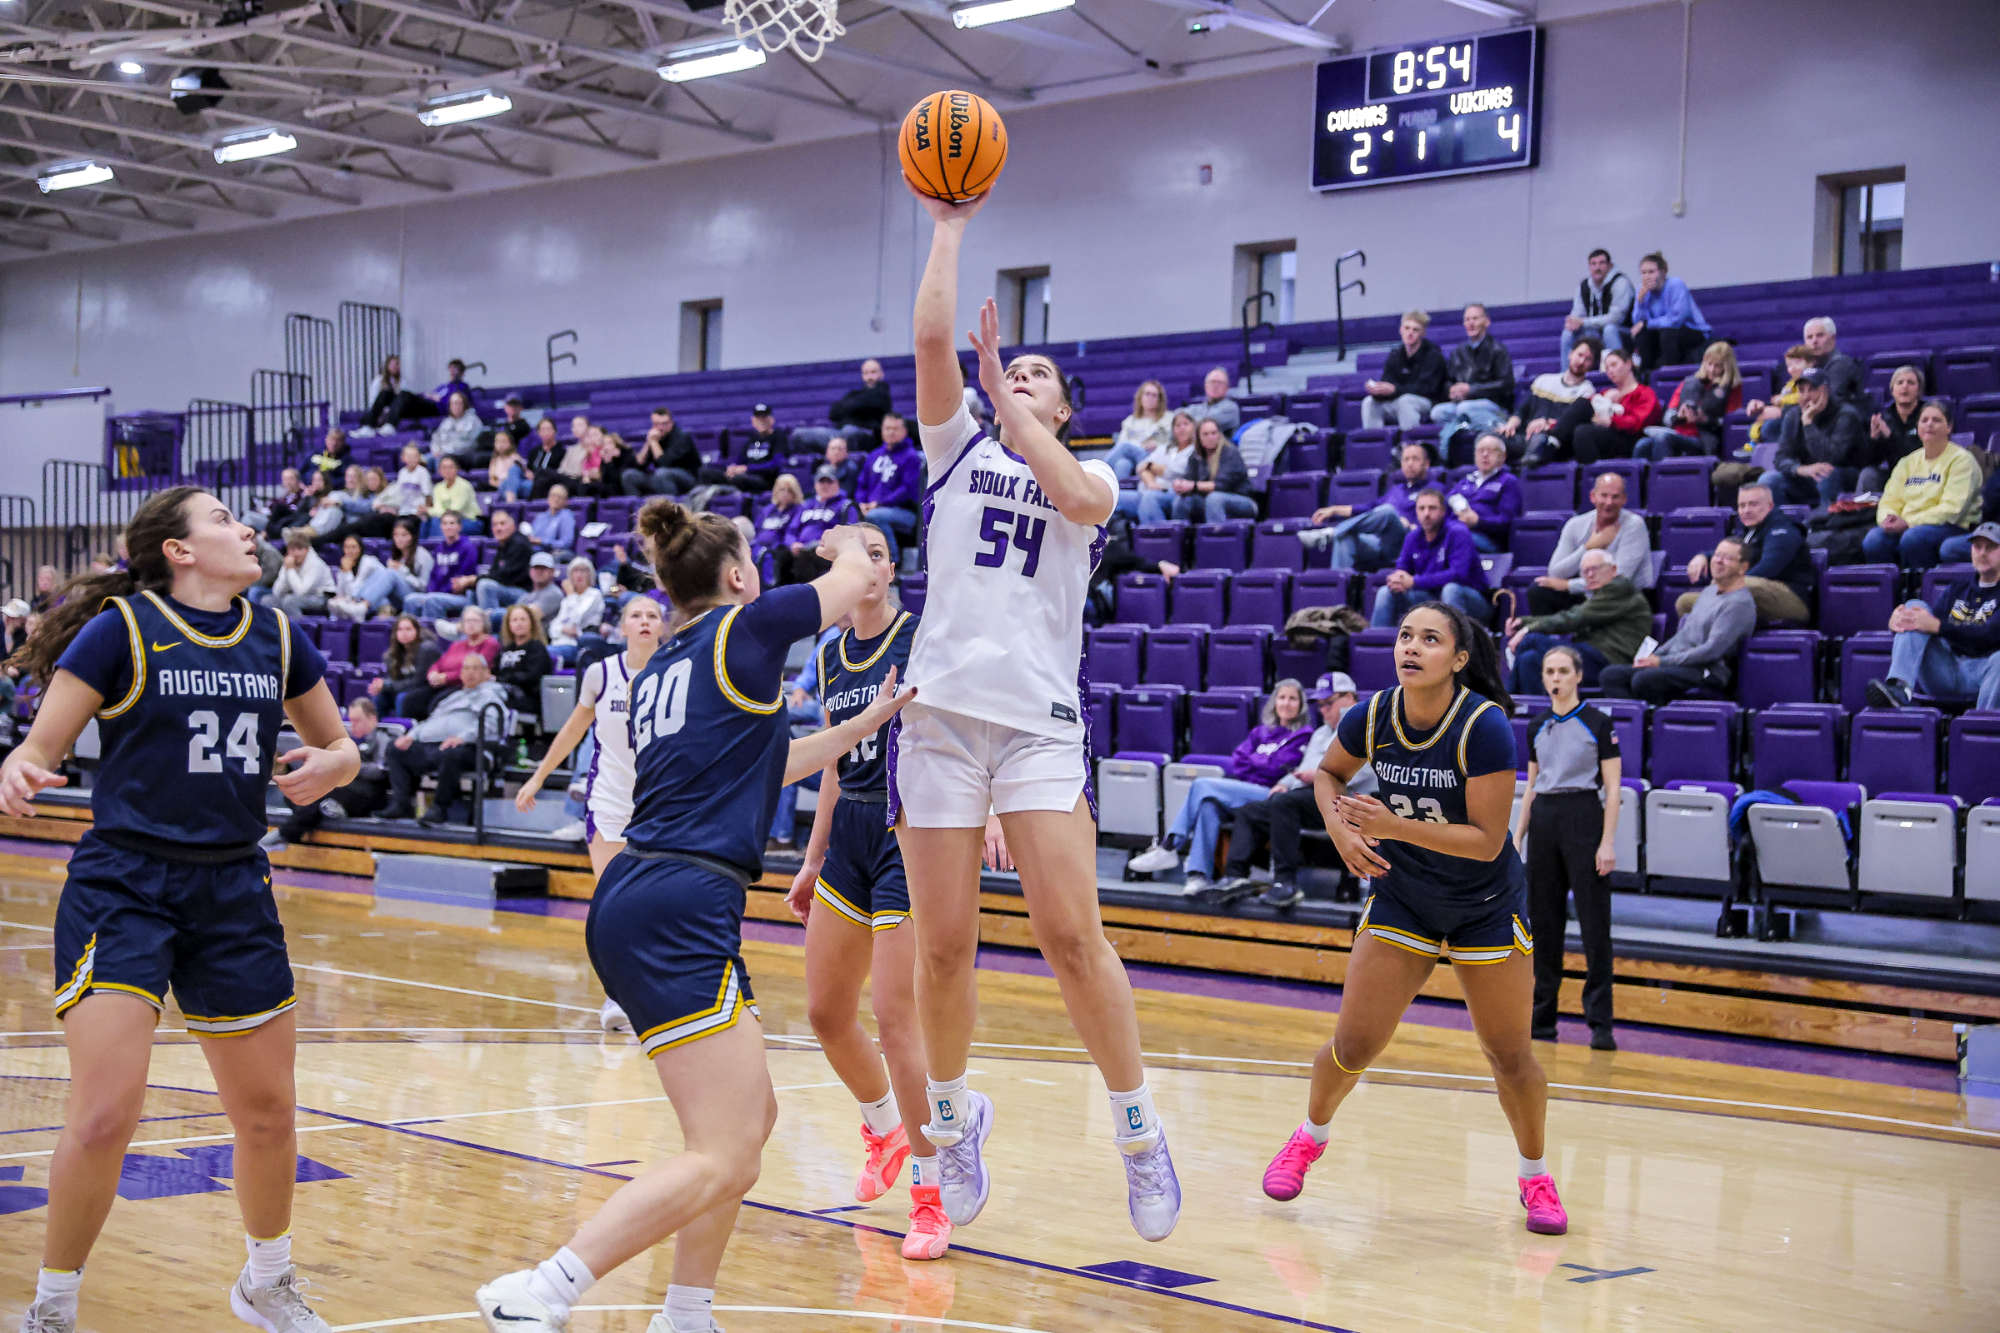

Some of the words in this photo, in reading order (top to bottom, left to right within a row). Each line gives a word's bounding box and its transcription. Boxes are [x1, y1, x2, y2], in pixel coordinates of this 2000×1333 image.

[1393, 44, 1471, 94] 8:54
[1327, 103, 1388, 132] COUGARS
[1450, 86, 1513, 115] VIKINGS
[916, 101, 932, 151] NCAA
[949, 94, 970, 158] Wilson
[1417, 130, 1426, 160] 1
[1497, 114, 1521, 153] 4
[1350, 131, 1372, 175] 2
[969, 469, 1020, 500] SIOUX
[974, 506, 1047, 578] 54
[159, 669, 278, 700] AUGUSTANA
[634, 657, 693, 756] 20
[188, 710, 260, 774] 24
[1375, 760, 1458, 788] AUGUSTANA
[1389, 793, 1449, 824] 23
